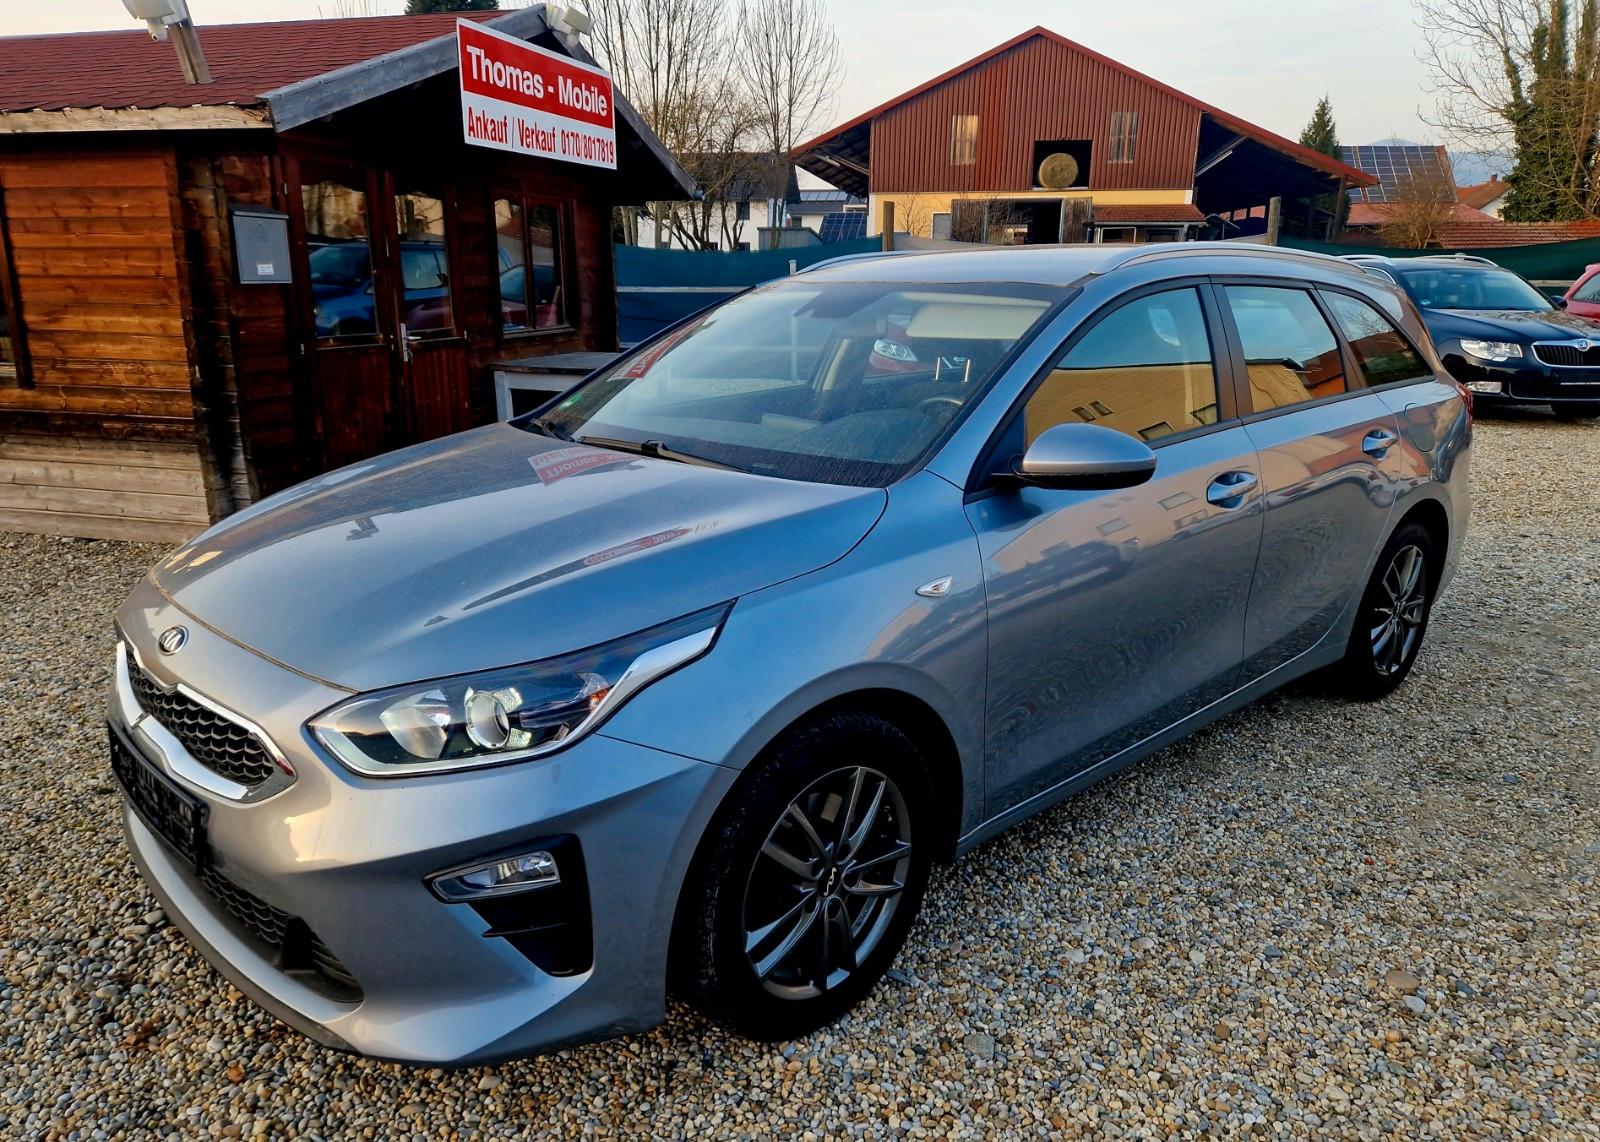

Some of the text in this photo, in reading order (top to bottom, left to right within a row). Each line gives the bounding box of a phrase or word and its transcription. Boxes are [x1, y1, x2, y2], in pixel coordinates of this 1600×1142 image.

[466, 45, 544, 99] Thomas
[558, 75, 608, 117] Mobile
[468, 107, 508, 144] Ankauf
[518, 118, 556, 153] Verkauf
